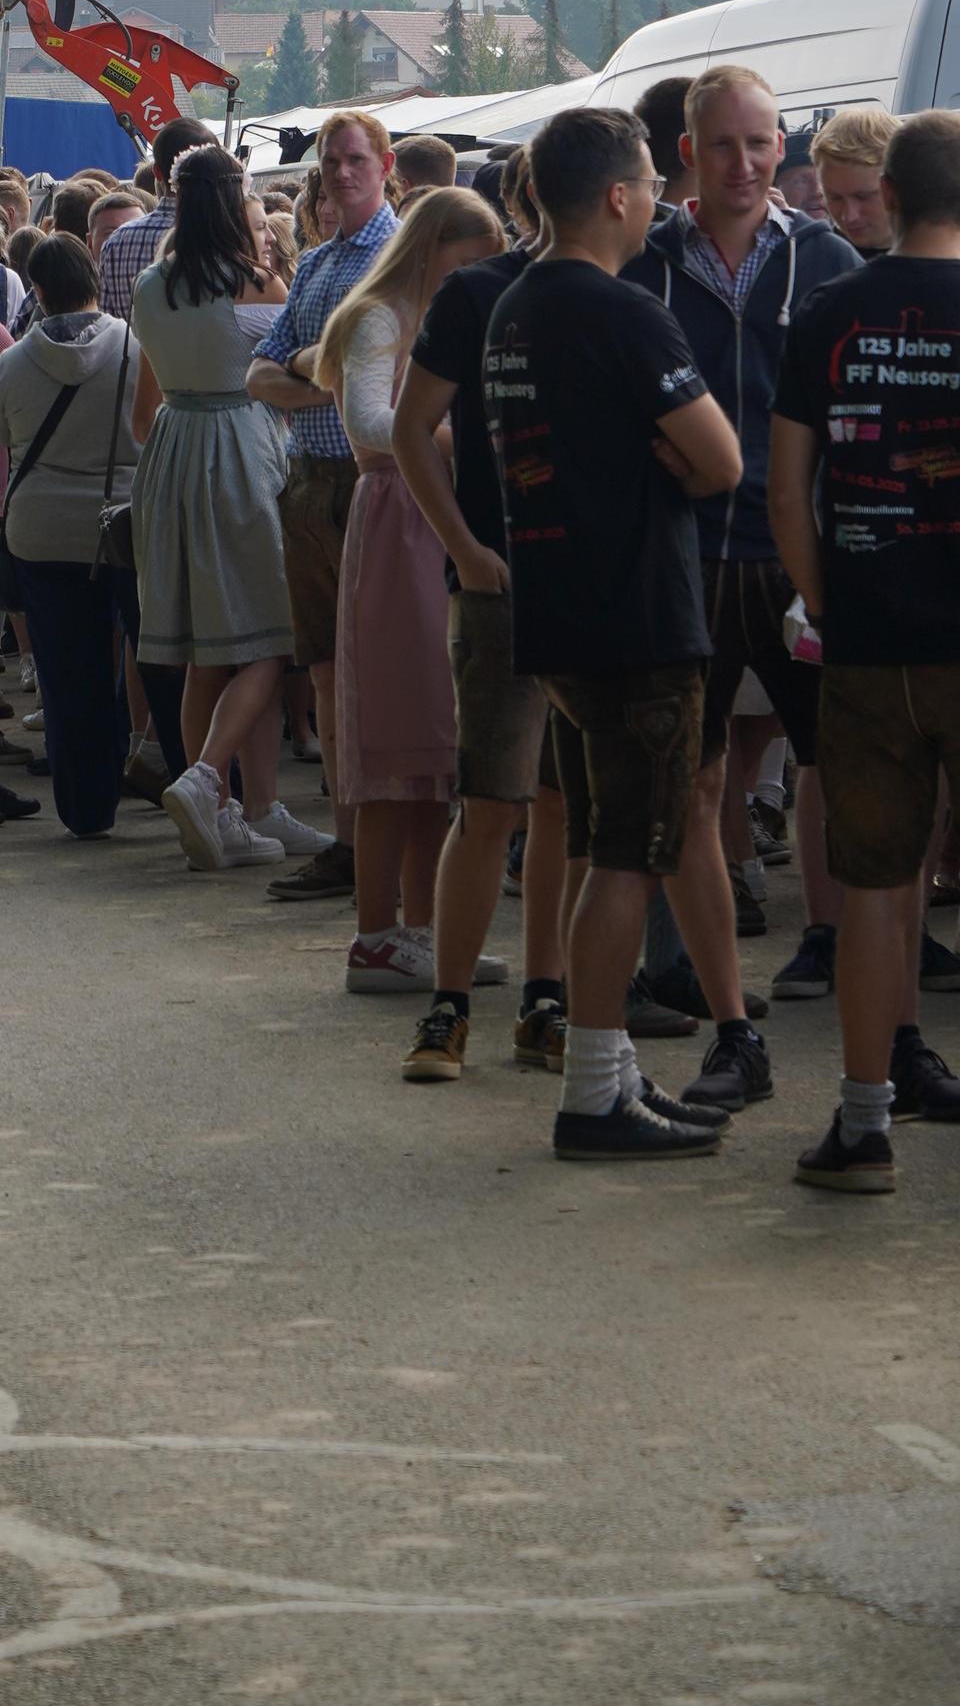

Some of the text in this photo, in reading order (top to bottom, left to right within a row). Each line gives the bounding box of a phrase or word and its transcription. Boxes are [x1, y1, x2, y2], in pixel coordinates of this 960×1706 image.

[857, 336, 952, 358] 125 Jahre
[501, 352, 528, 372] Jahre
[846, 364, 960, 390] FF Neusorg
